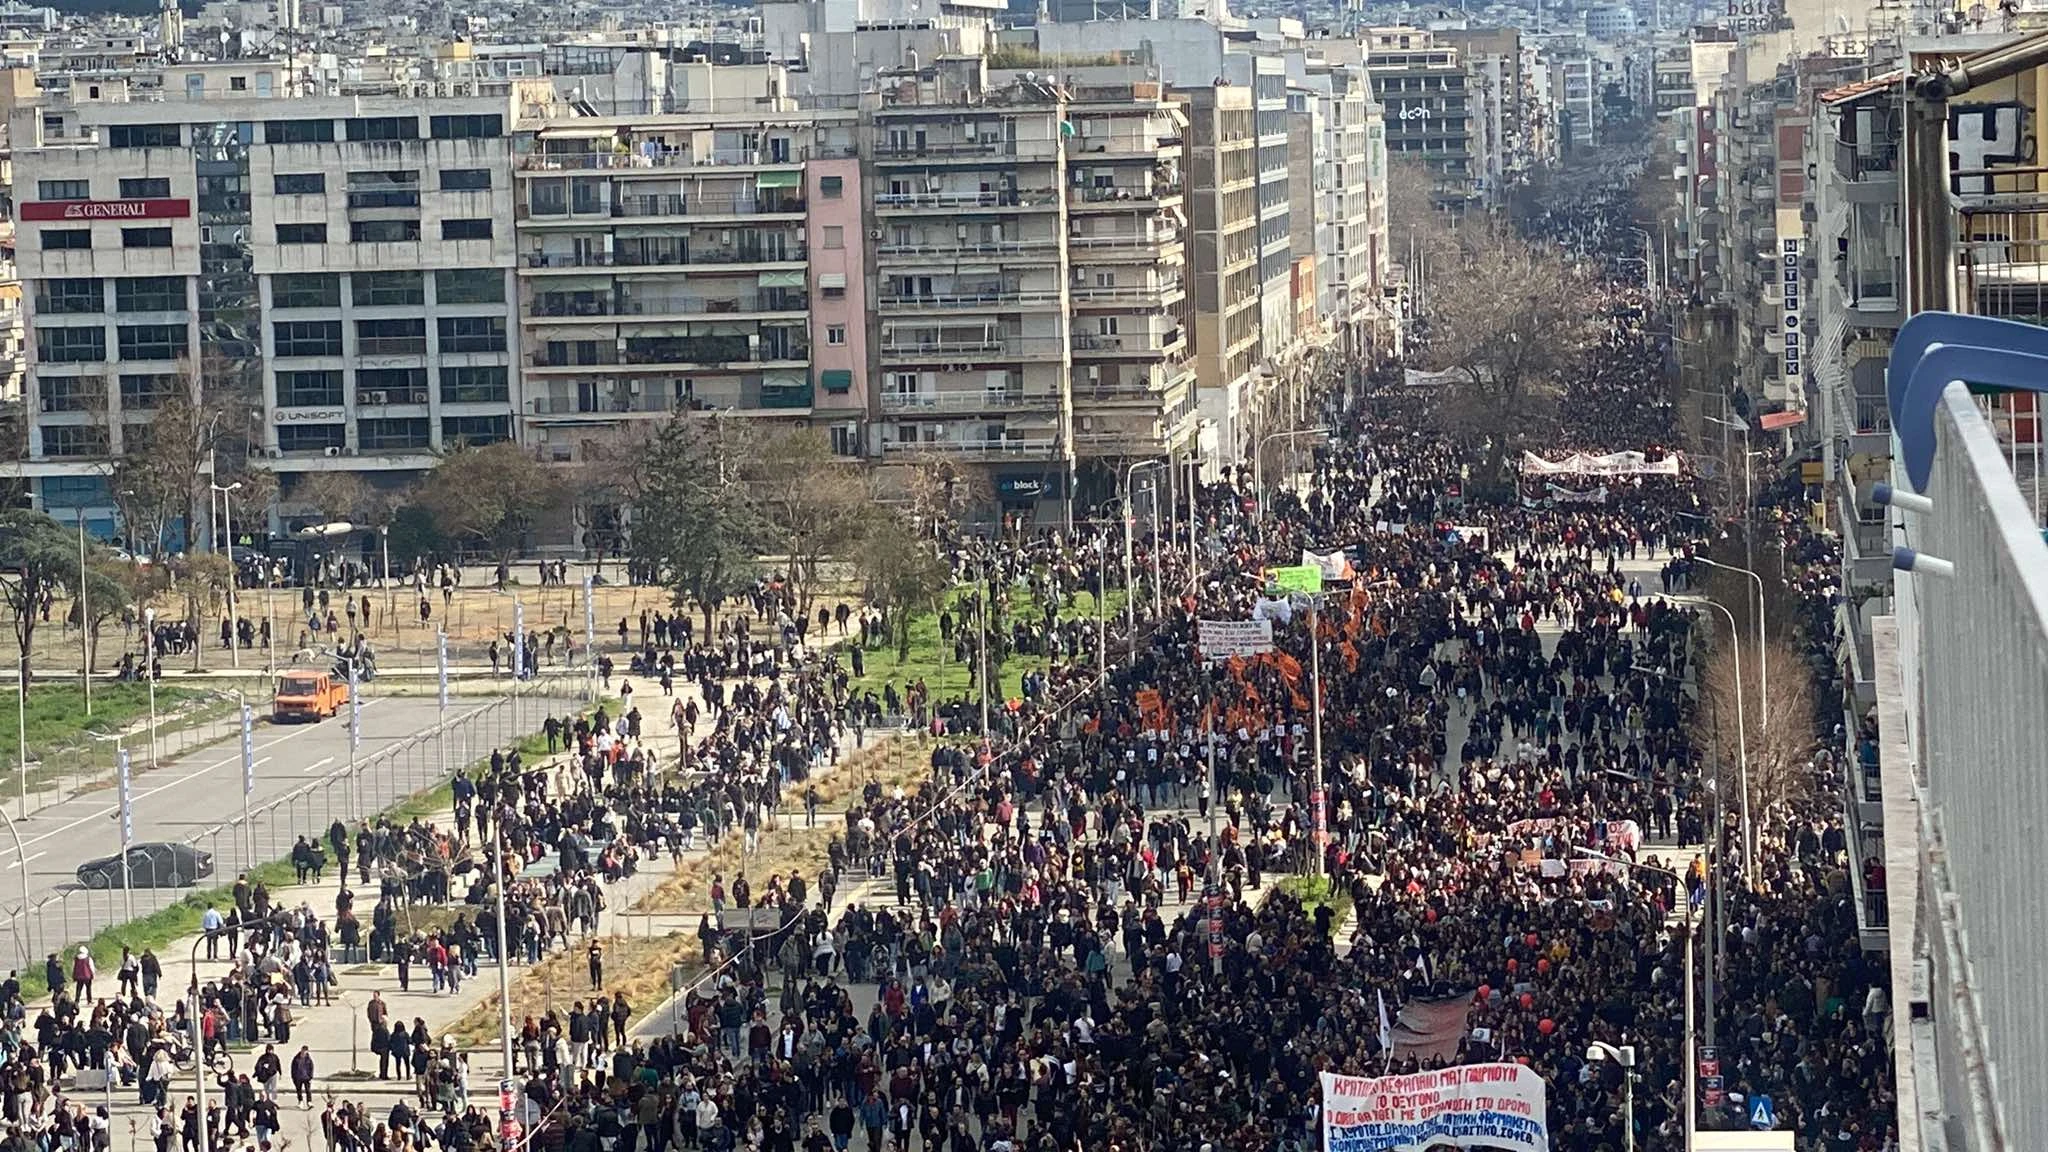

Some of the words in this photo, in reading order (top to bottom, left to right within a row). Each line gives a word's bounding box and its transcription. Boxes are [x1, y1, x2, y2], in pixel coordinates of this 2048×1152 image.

[84, 203, 146, 216] GENERALI
[1785, 240, 1797, 310] HOTEL
[1785, 333, 1798, 374] REX
[288, 411, 344, 420] UNISOFT
[1401, 1109, 1415, 1121] ΜΕ
[1476, 1097, 1493, 1110] ΣΤΟ
